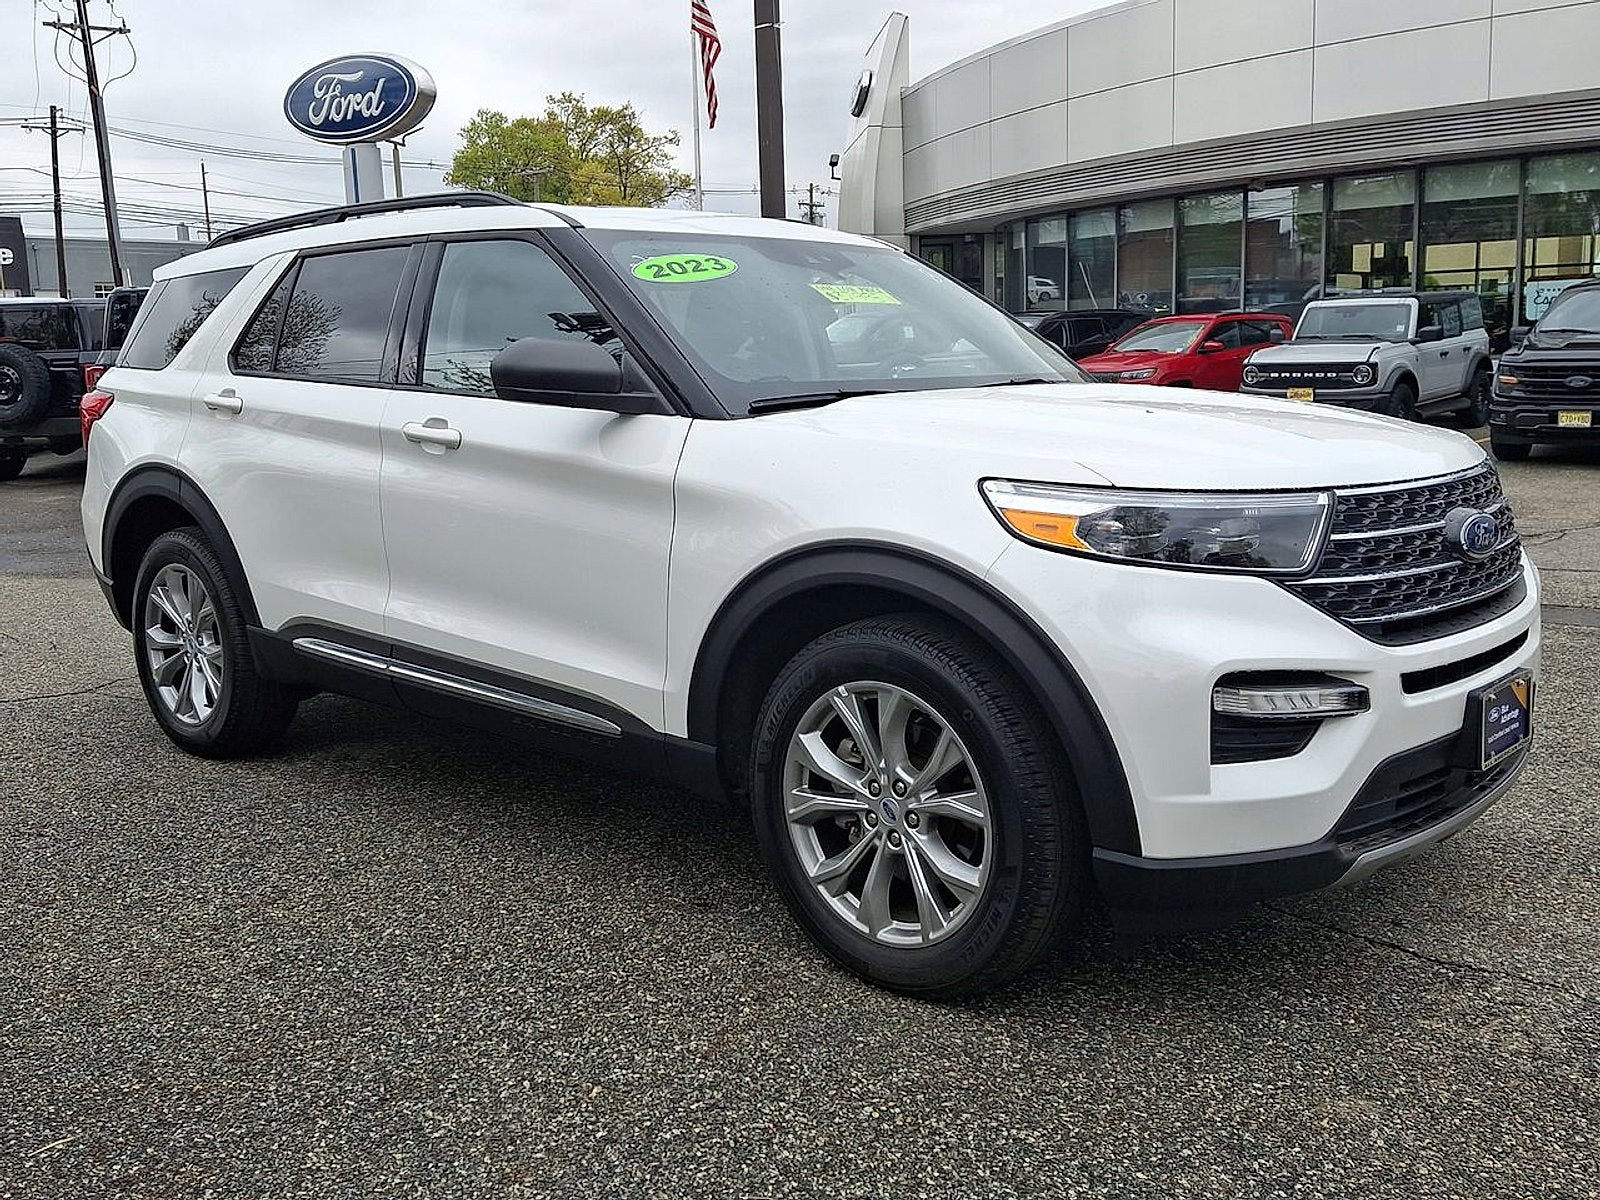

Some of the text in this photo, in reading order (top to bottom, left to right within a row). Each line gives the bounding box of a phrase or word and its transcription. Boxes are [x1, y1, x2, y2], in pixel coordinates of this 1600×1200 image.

[308, 70, 387, 126] Ford
[646, 257, 727, 279] 2023
[1474, 522, 1497, 547] Ford
